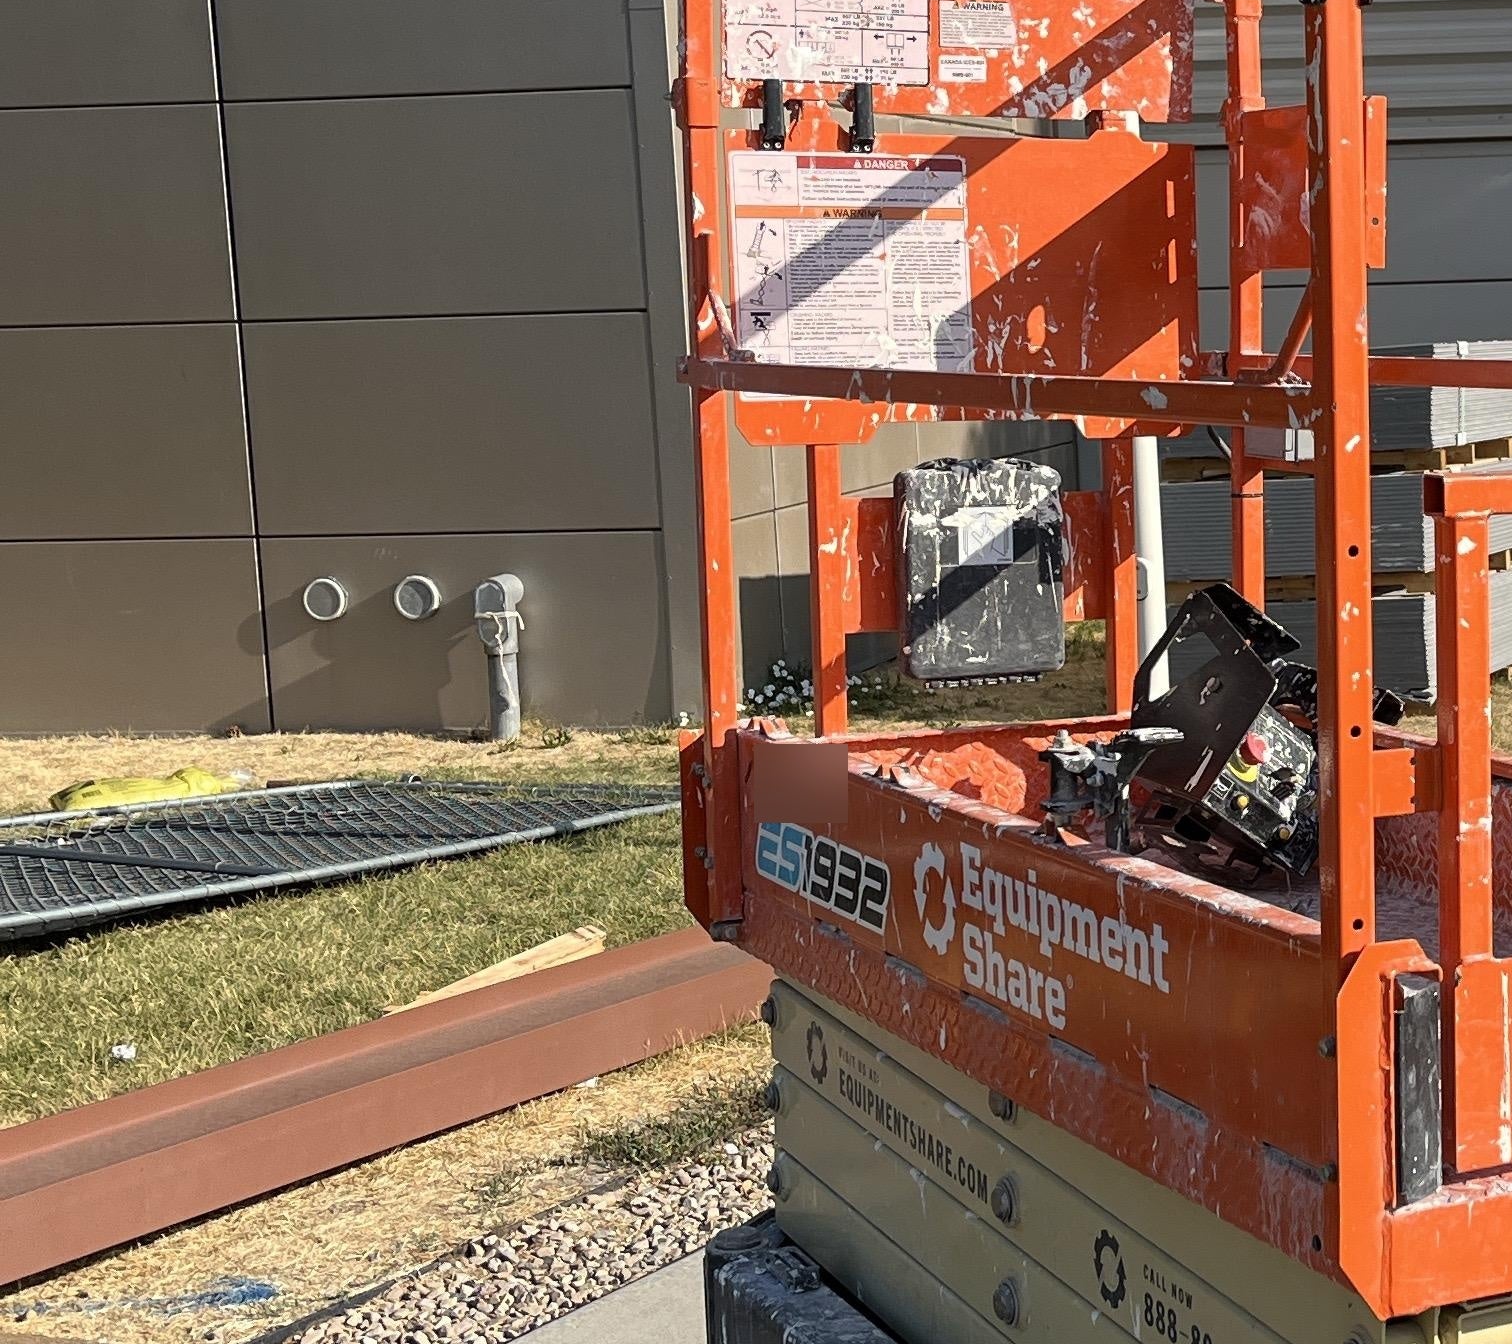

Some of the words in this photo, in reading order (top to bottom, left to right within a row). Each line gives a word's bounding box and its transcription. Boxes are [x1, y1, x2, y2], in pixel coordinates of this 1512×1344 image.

[963, 2, 1004, 12] WARNING
[863, 159, 909, 170] DANGER
[833, 208, 882, 219] WARNING
[961, 841, 1171, 994] Equipment
[961, 922, 1067, 1031] Share
[839, 1067, 988, 1205] EQUIPMENTSHARE.COM
[1143, 1264, 1167, 1293] CALL
[1171, 1283, 1193, 1310] NOW
